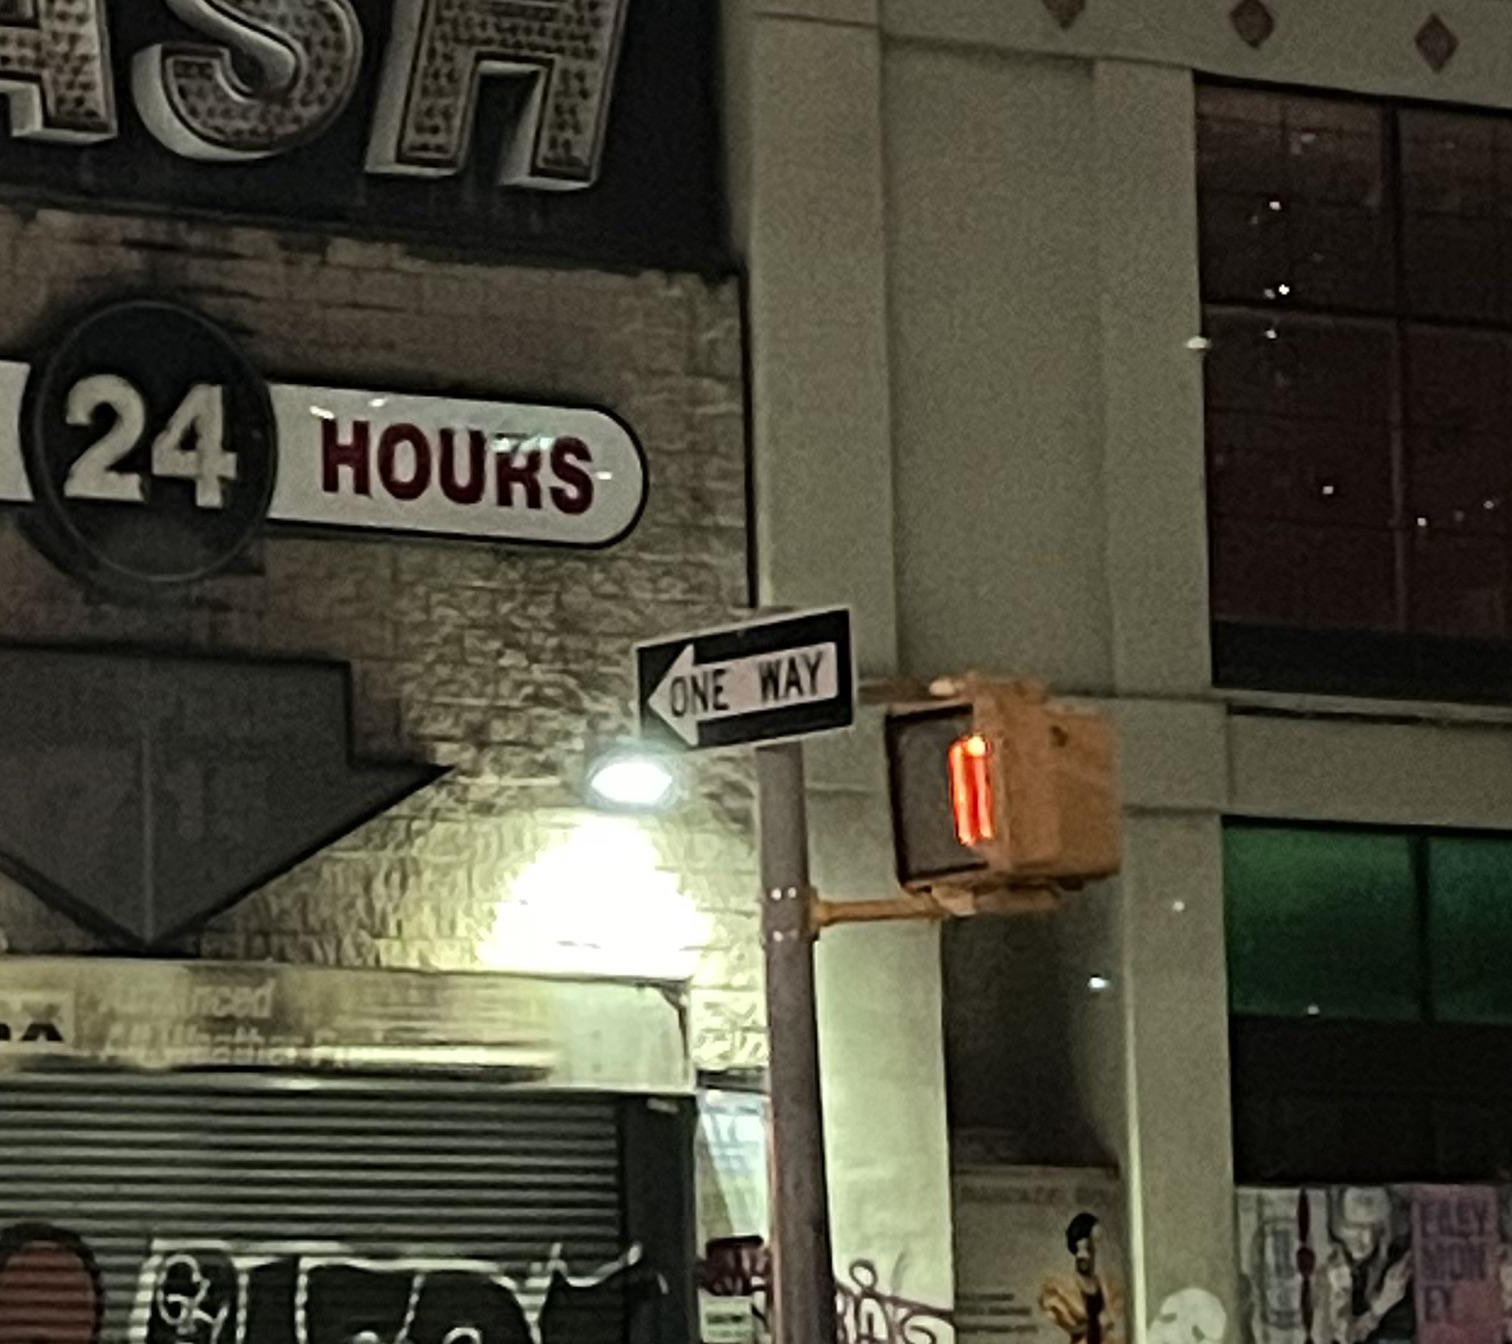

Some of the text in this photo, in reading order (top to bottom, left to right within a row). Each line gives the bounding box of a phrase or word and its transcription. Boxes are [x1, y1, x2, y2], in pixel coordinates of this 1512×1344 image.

[63, 373, 240, 508] 24
[321, 418, 594, 515] HOURS
[669, 651, 824, 718] ONE WAY
